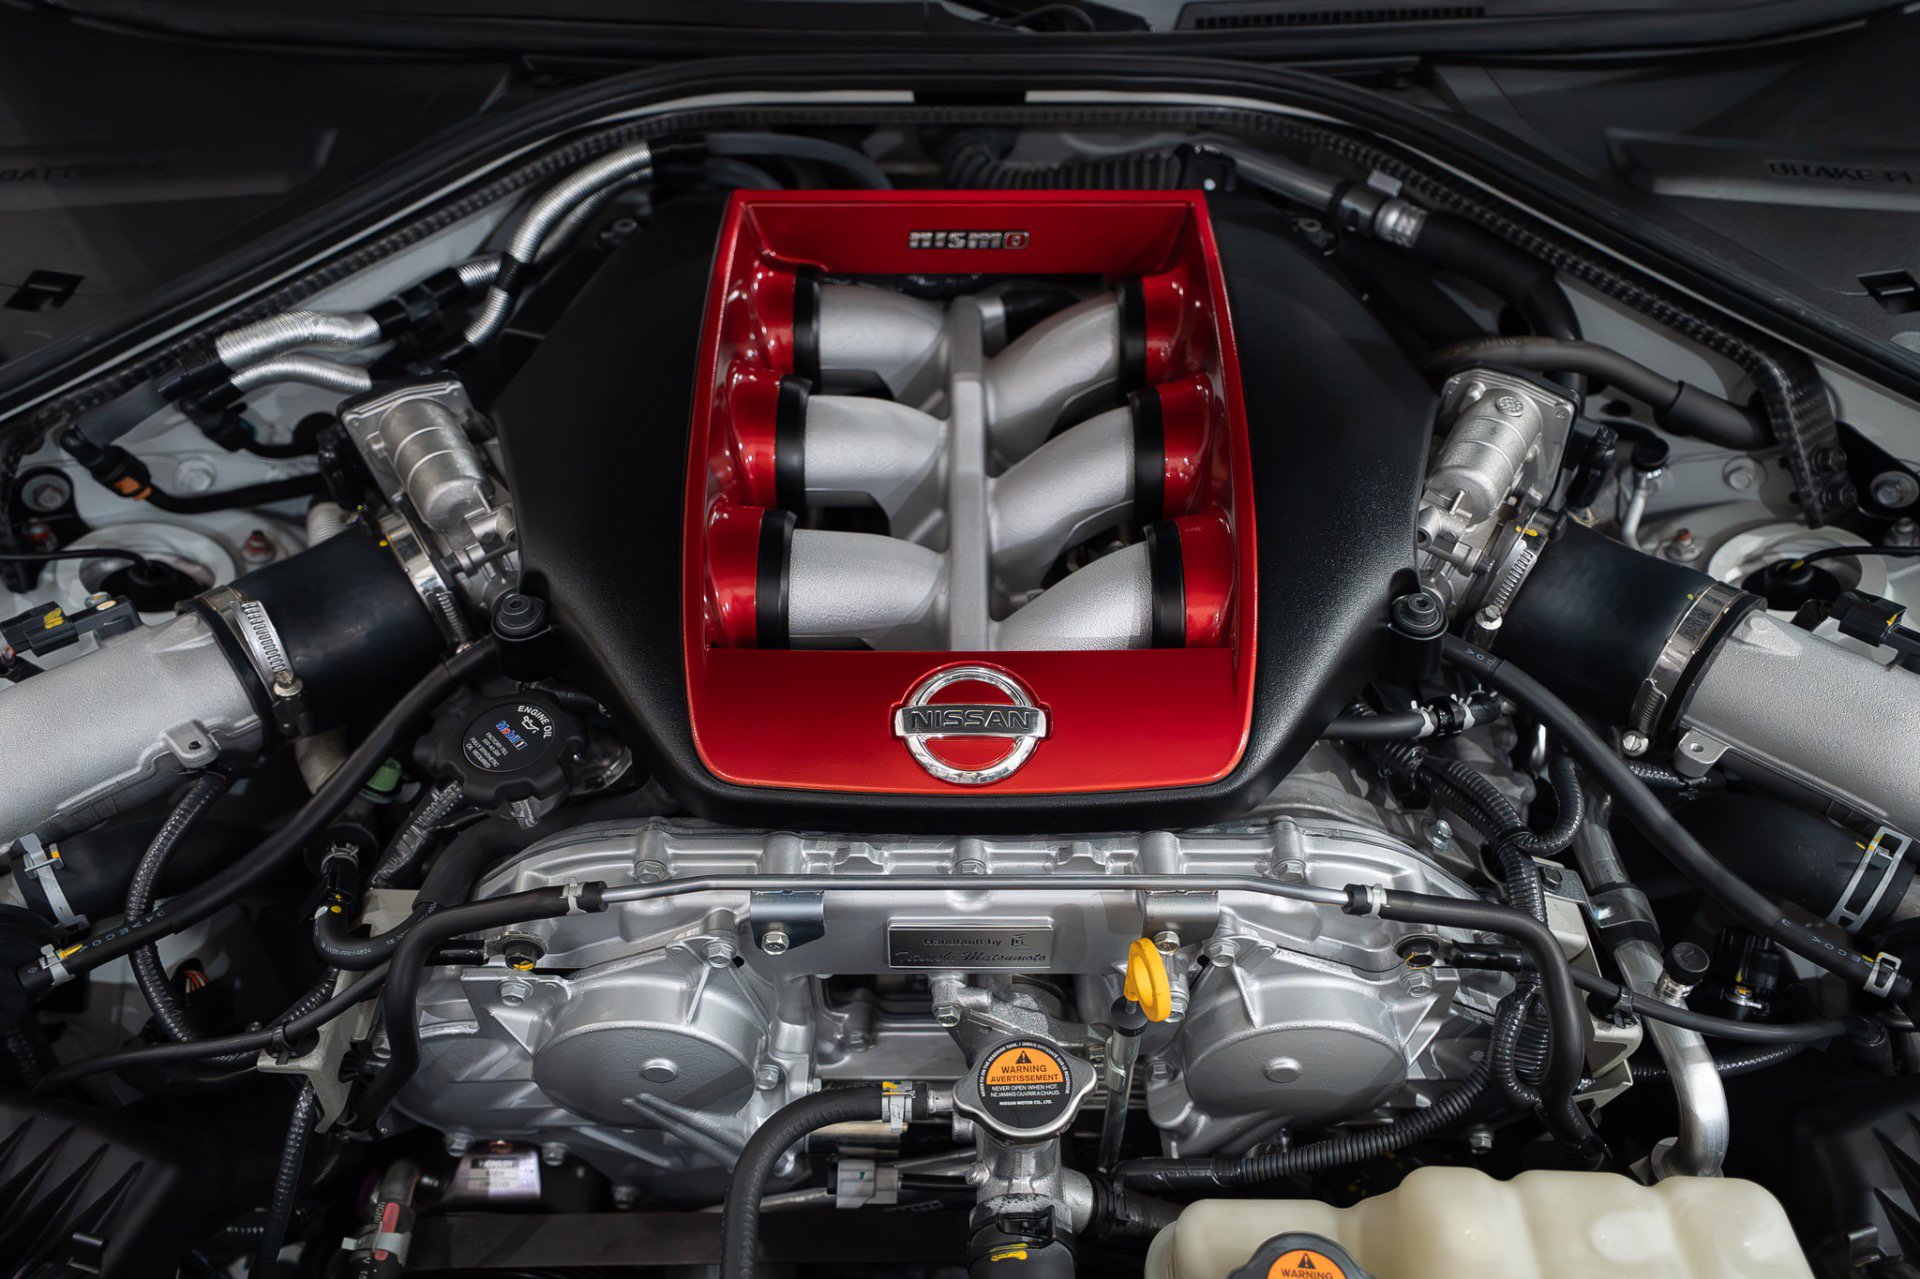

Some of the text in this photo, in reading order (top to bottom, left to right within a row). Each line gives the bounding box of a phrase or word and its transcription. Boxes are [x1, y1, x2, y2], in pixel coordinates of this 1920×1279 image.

[517, 705, 552, 739] ENGINE OIL
[911, 710, 1030, 729] NISSAN
[496, 720, 520, 743] Mobil
[1001, 1065, 1047, 1074] WARNING
[990, 1074, 1059, 1083] AVERTISSEMENT
[1281, 1268, 1333, 1279] WARNING
